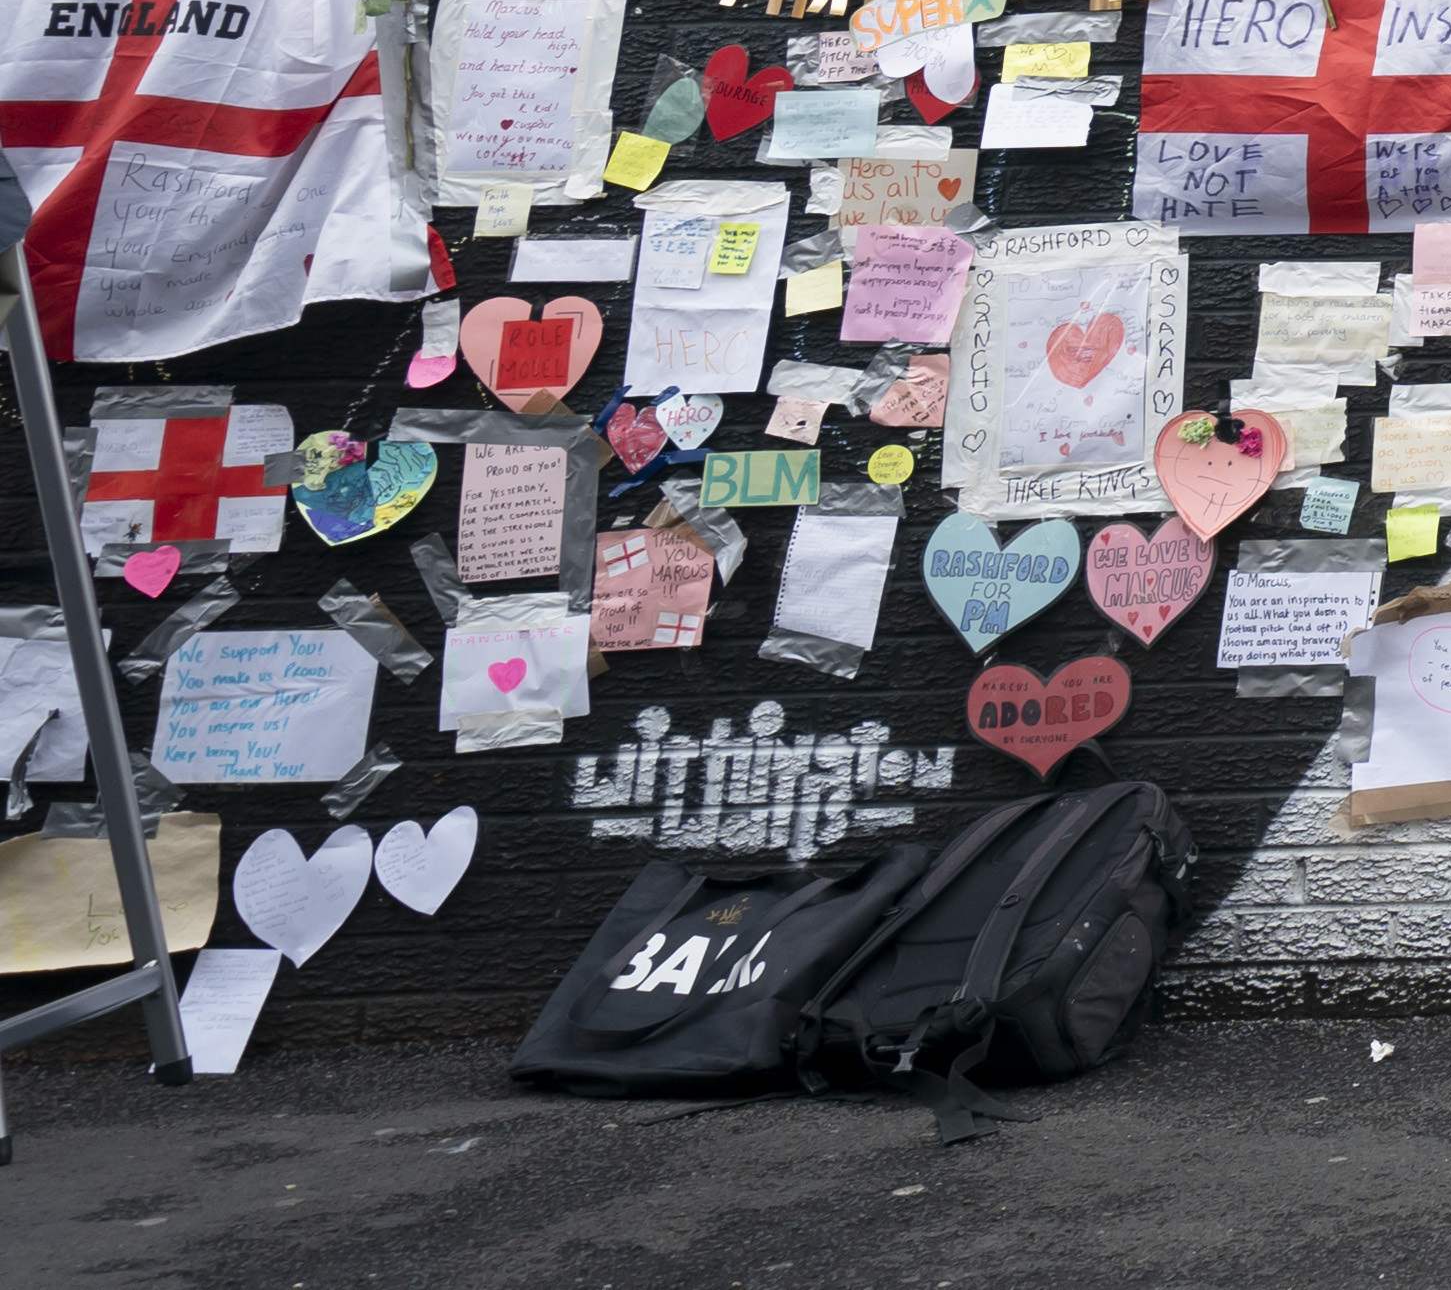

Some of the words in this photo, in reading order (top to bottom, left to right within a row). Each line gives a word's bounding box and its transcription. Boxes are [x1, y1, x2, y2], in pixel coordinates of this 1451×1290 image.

[43, 1, 252, 39] ENGLAND
[1180, 0, 1318, 48] HERO
[464, 22, 497, 40] Hold
[494, 29, 530, 48] your
[533, 26, 566, 40] head
[458, 60, 486, 72] and
[489, 59, 526, 72] heart
[528, 62, 569, 79] strong
[463, 84, 485, 102] You
[483, 88, 506, 106] got
[512, 88, 536, 100] this
[707, 77, 770, 108] COURAGE
[1159, 139, 1264, 164] LOVE
[847, 157, 895, 181] Hero
[911, 159, 944, 180] to
[886, 175, 921, 199] all
[1184, 170, 1249, 194] NOT
[1161, 196, 1265, 220] HATE
[1004, 227, 1112, 256] RASHFORD
[509, 326, 565, 347] ROLE
[654, 326, 750, 375] HERO
[486, 465, 519, 478] PROUD
[704, 452, 820, 505] BLM
[1001, 475, 1062, 505] THREE
[664, 545, 698, 563] YOU
[931, 549, 1070, 583] RASHFORD
[1094, 547, 1128, 568] WE
[1134, 541, 1192, 566] LOVE
[650, 563, 710, 583] MARCUS
[1232, 573, 1246, 588] To
[1247, 573, 1291, 588] Marcus,
[971, 580, 1012, 600] FOR
[1102, 568, 1203, 607] MARCUS
[1287, 594, 1350, 607] inspiration
[961, 599, 1010, 634] PM
[450, 626, 574, 646] MANCHESTER
[177, 638, 204, 663] We
[220, 642, 278, 663] support
[981, 681, 1030, 692] MARCUS
[1061, 678, 1086, 688] YOU
[1092, 674, 1114, 684] ARE
[977, 691, 1114, 728] ADORED
